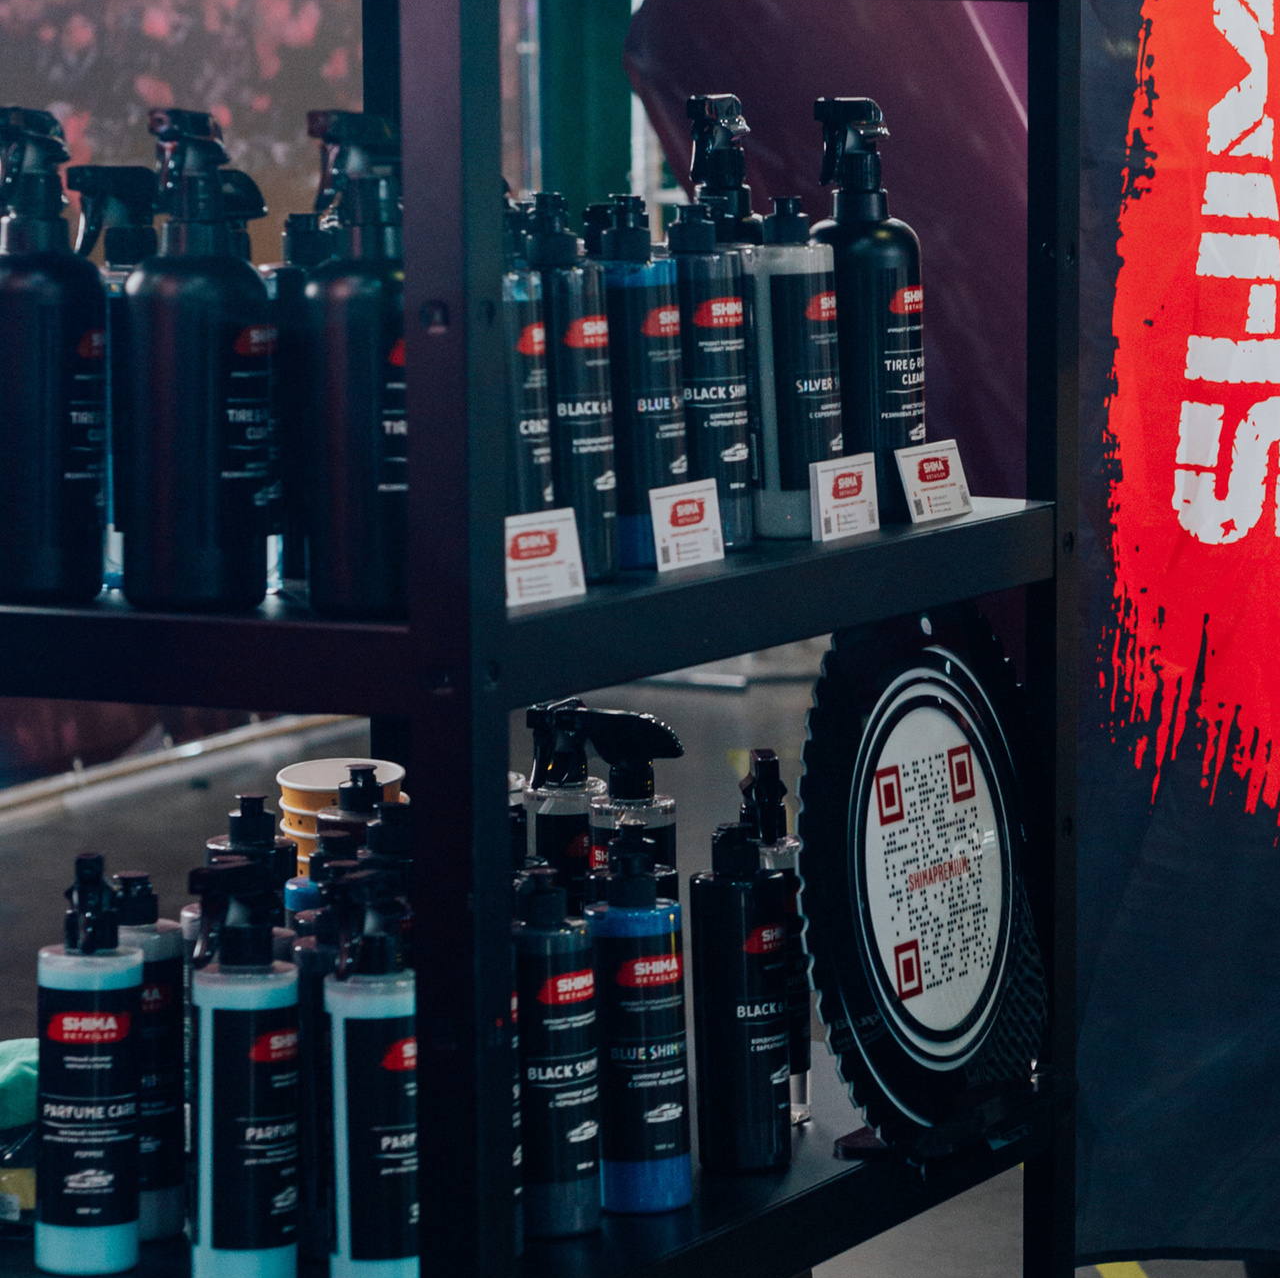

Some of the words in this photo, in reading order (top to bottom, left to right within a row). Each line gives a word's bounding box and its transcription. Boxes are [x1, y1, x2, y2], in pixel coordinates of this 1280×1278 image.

[884, 358, 908, 372] TIRE
[795, 376, 833, 393] SILVER
[684, 386, 726, 401] BLACK
[556, 401, 600, 417] BLACK
[637, 397, 670, 413] BLUE
[923, 460, 945, 475] SHIMA
[908, 856, 968, 892] SHIMAPREMIUM
[633, 957, 679, 976] SHIMA
[736, 1002, 776, 1019] BLACK
[61, 1016, 118, 1032] SHIMA
[611, 1045, 646, 1060] BLUE
[528, 1064, 574, 1081] BLACK
[43, 1102, 105, 1120] PARFUME
